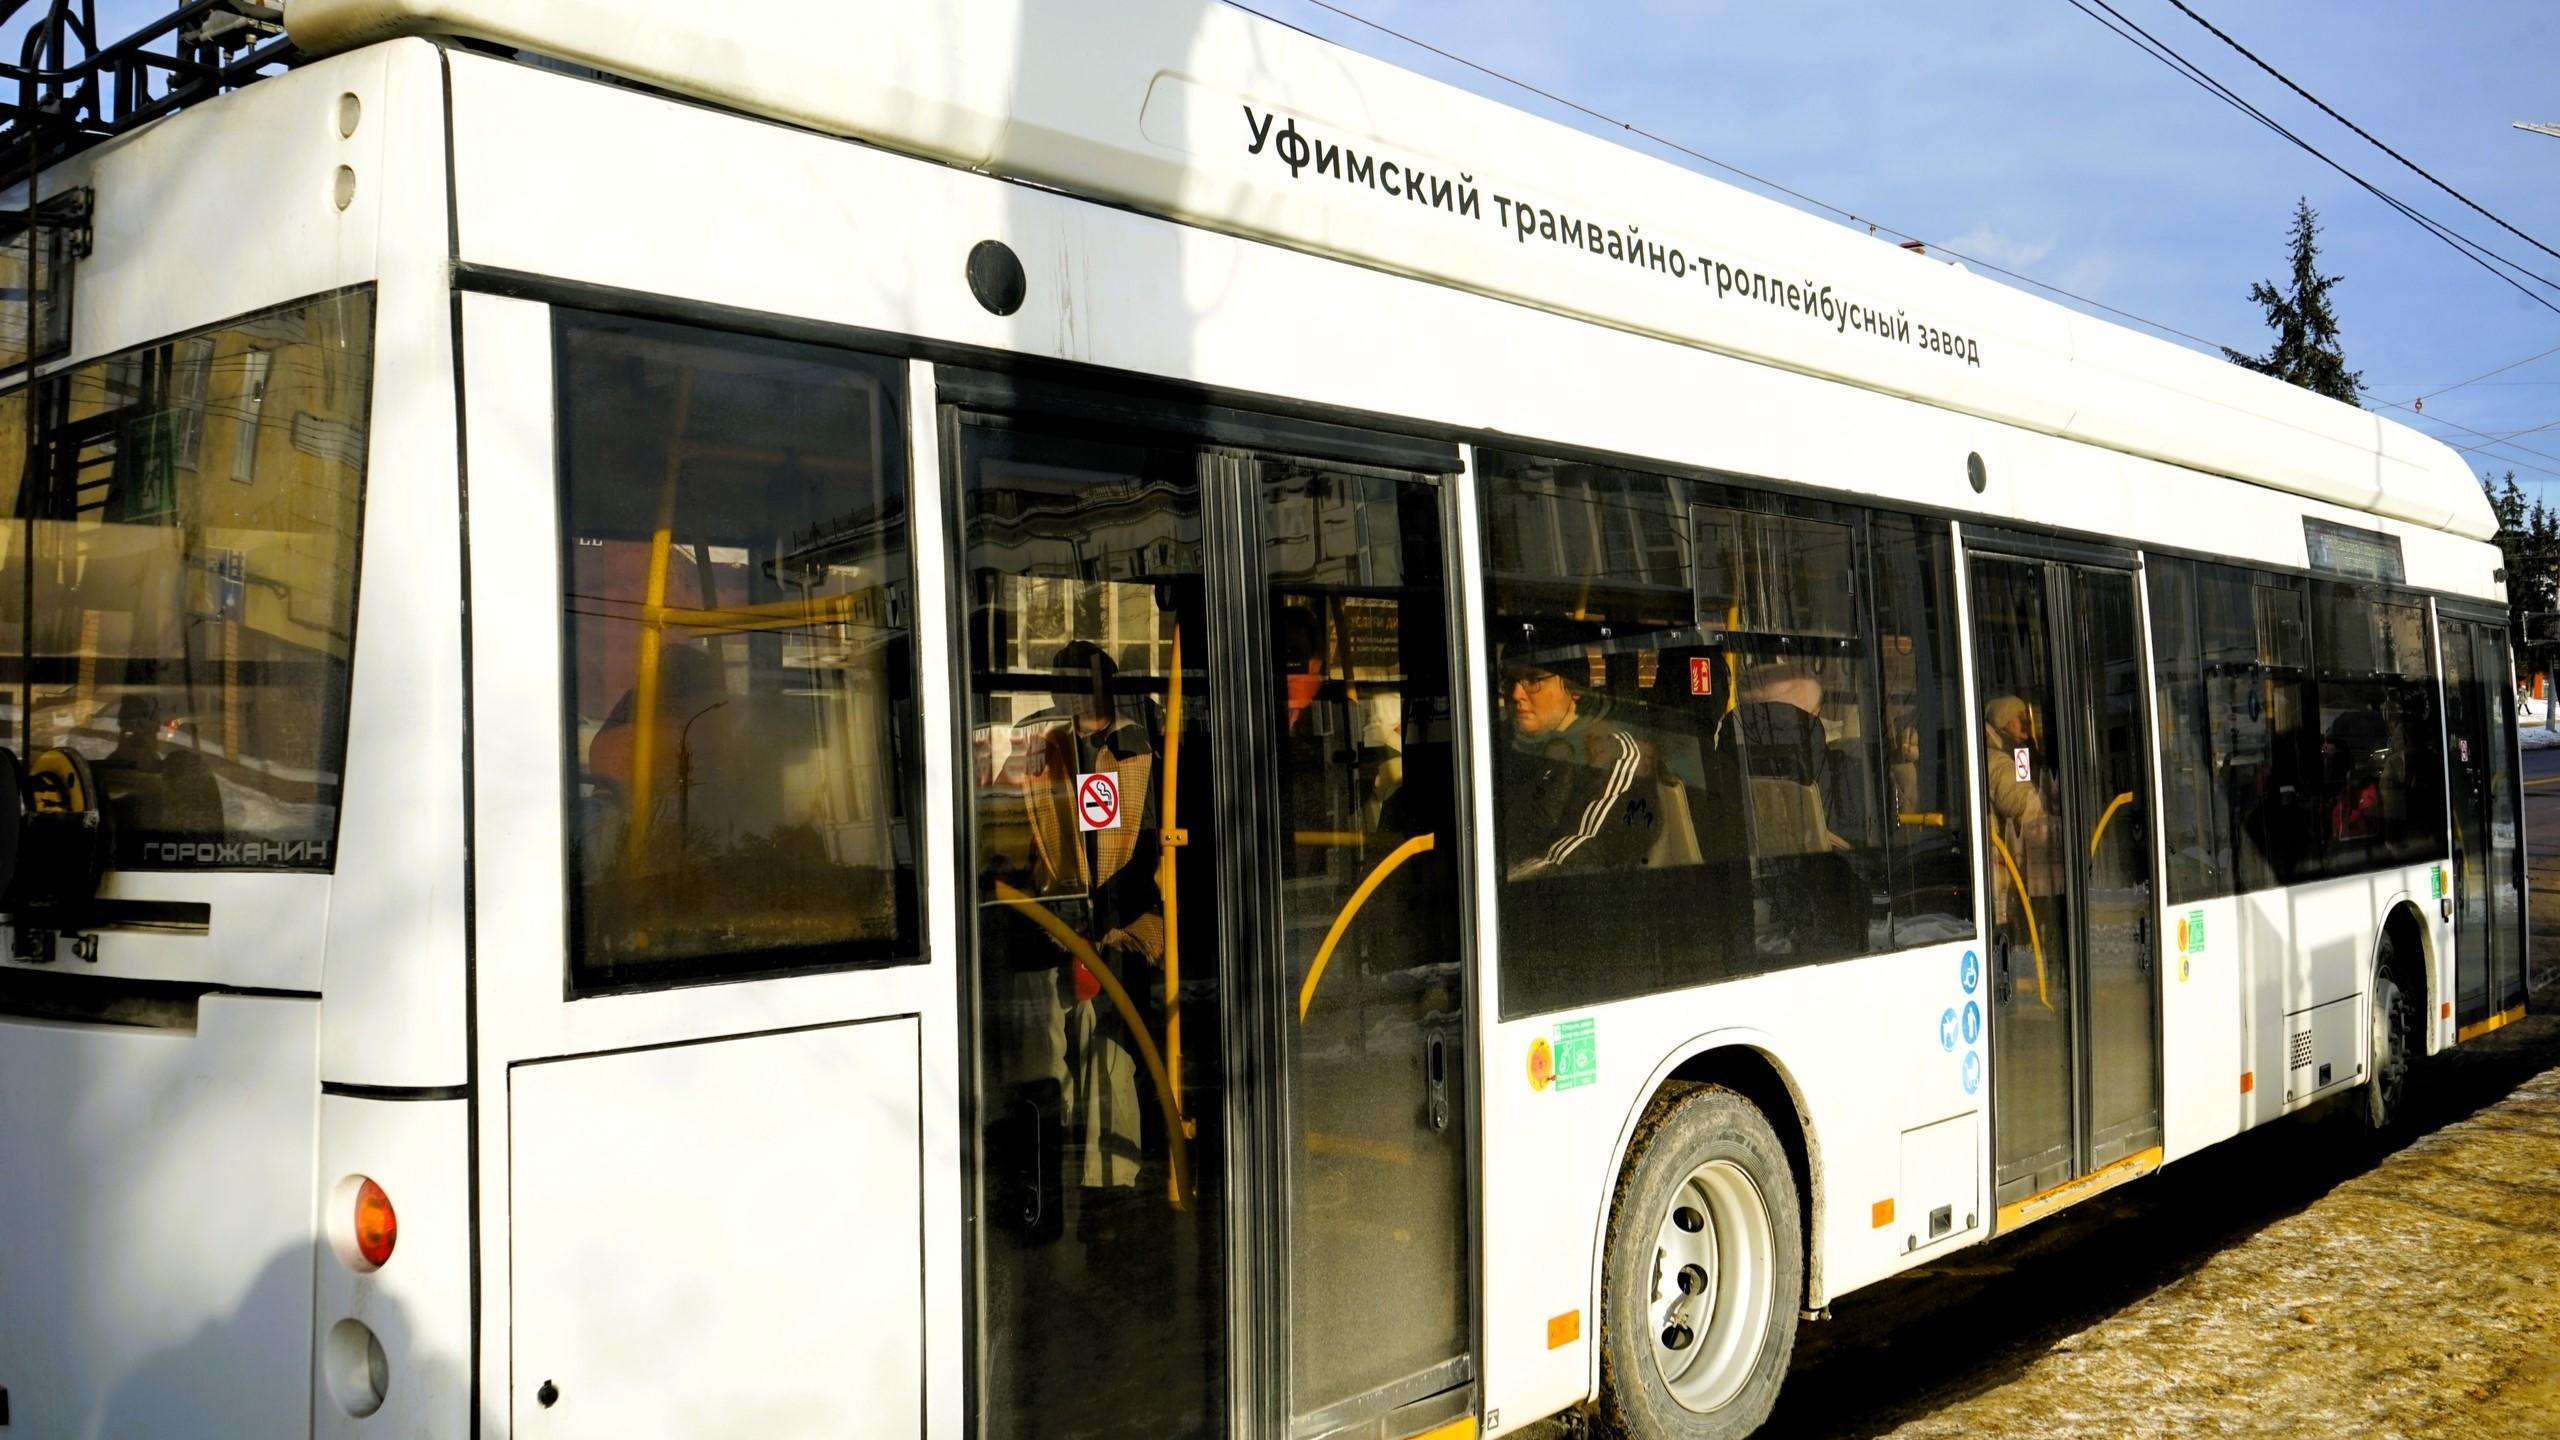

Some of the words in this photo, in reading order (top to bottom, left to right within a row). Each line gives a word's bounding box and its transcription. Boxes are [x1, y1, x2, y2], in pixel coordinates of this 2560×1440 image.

[1243, 105, 1481, 221] Уфимский
[1493, 193, 1911, 345] трамвайно-троллейбусный
[1917, 323, 1981, 369] завод
[143, 840, 327, 862] ГОРОЖАНИН
